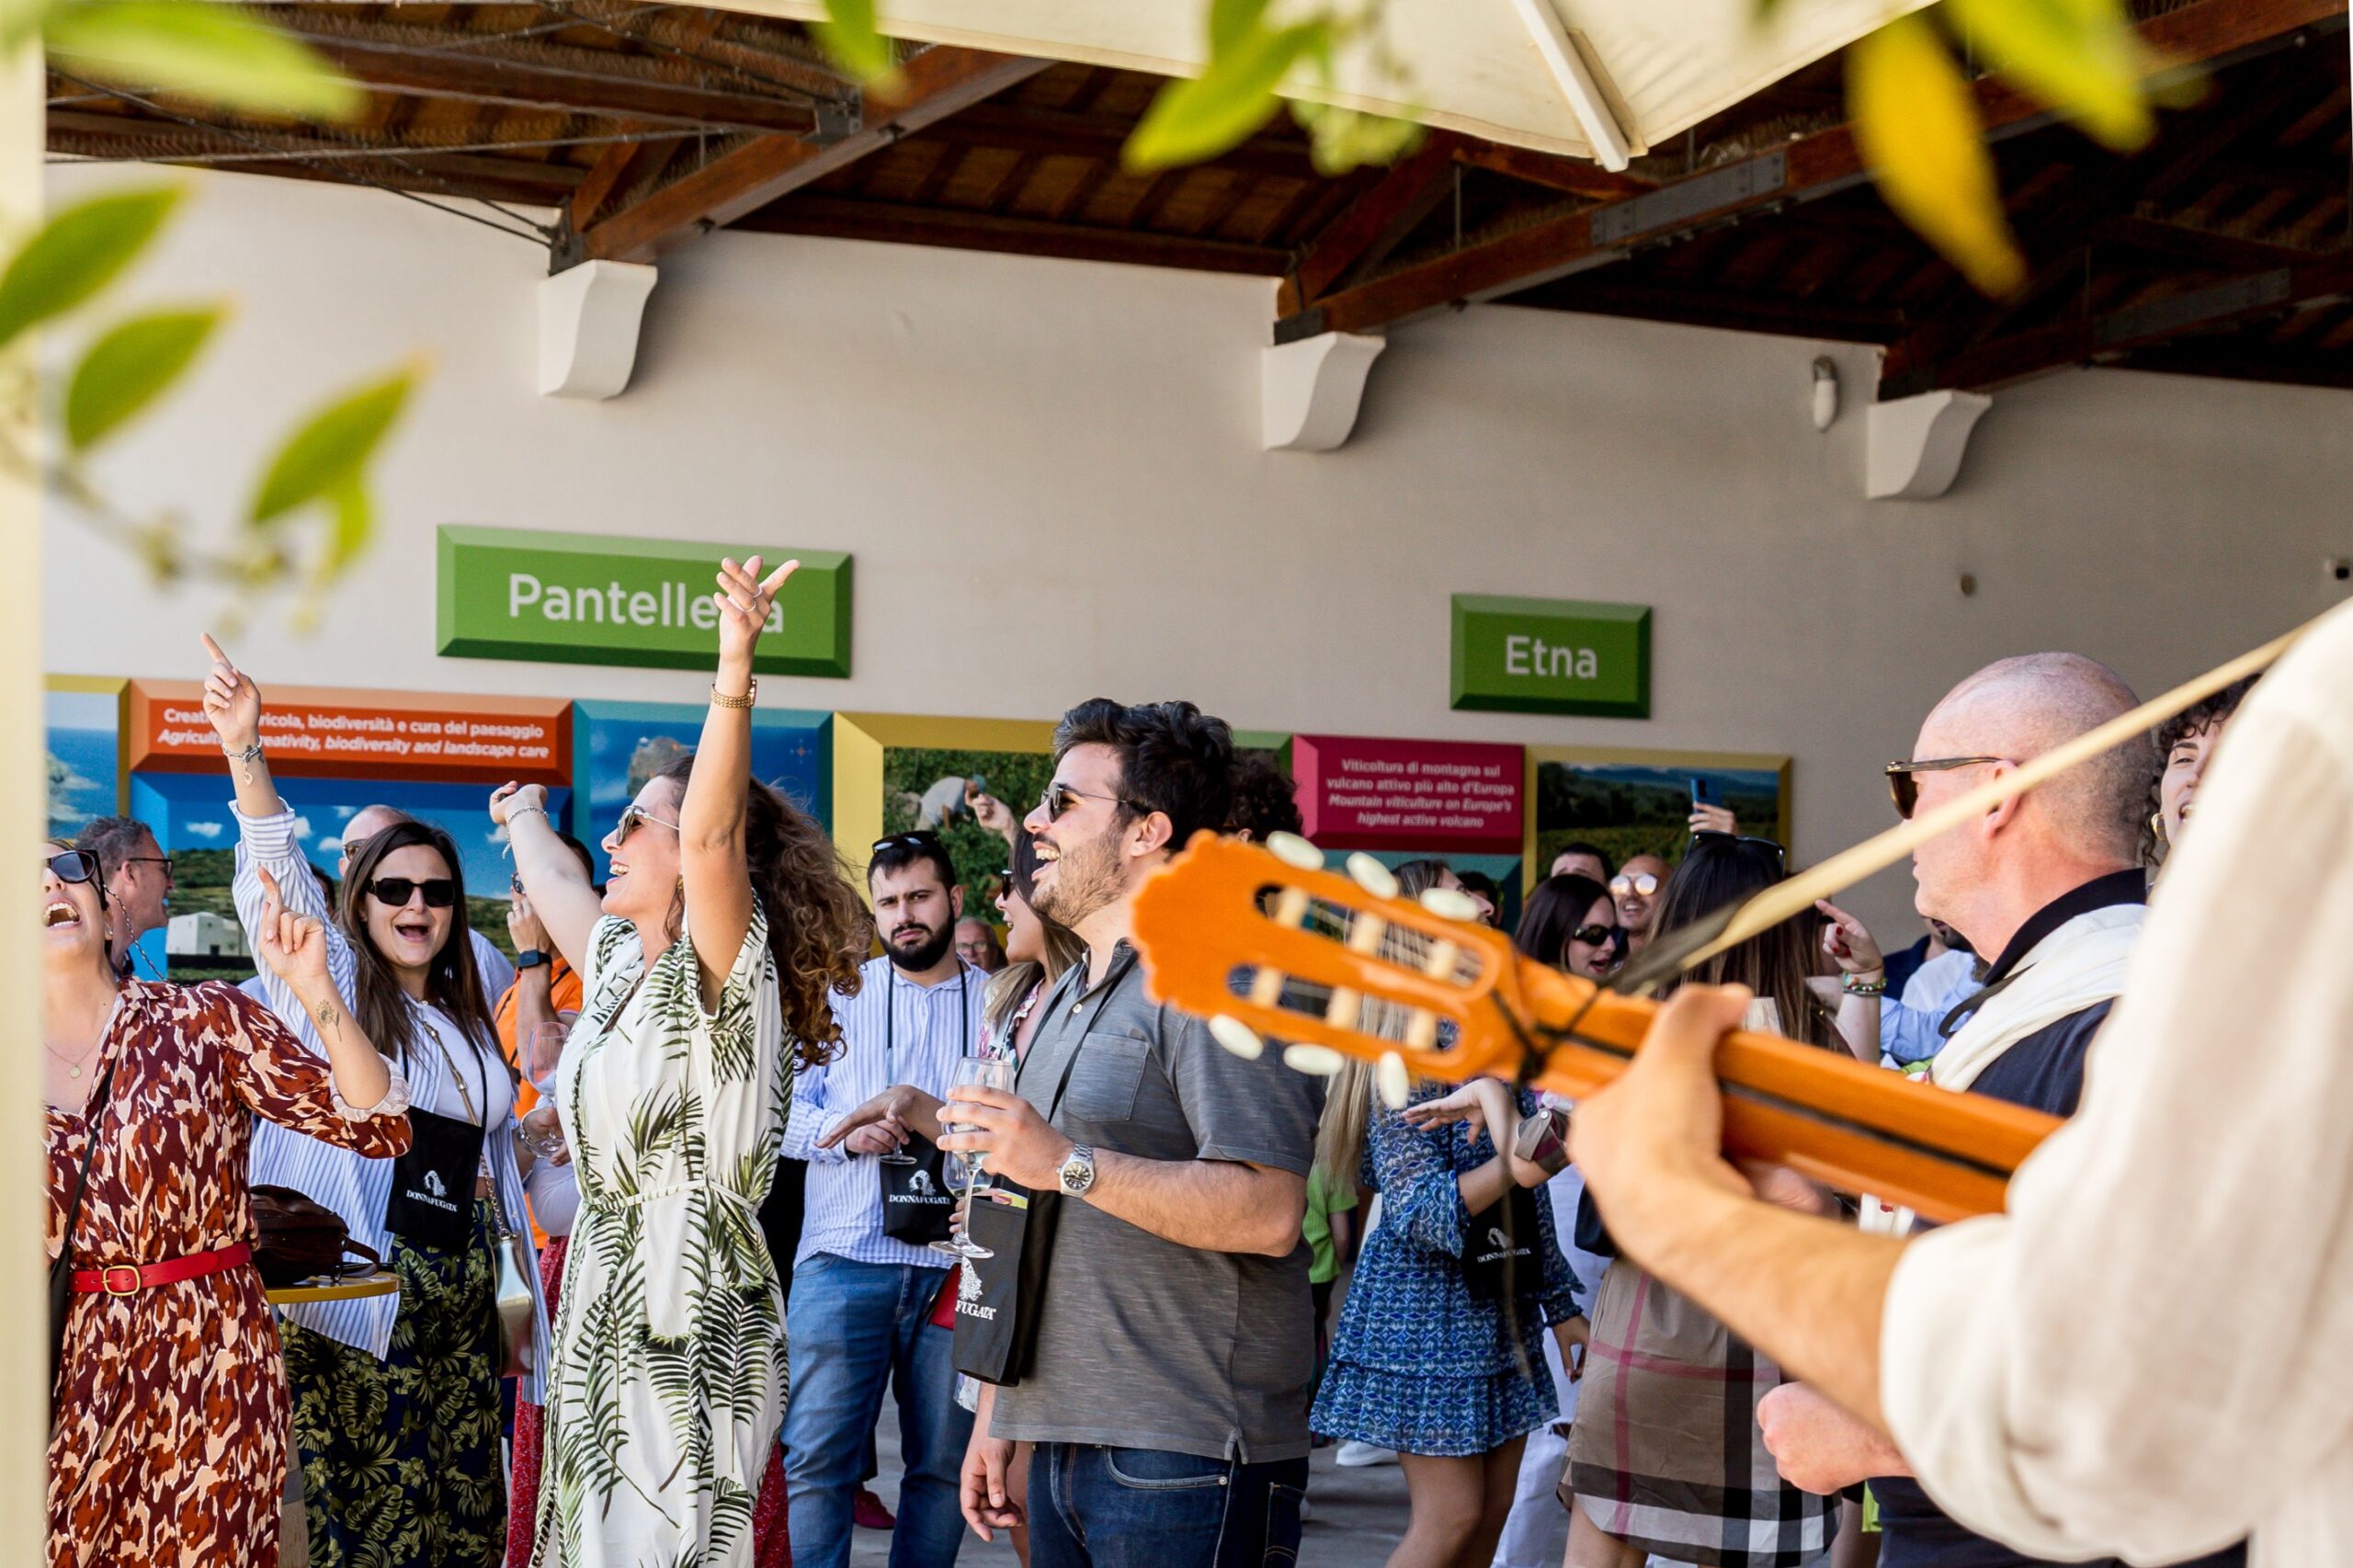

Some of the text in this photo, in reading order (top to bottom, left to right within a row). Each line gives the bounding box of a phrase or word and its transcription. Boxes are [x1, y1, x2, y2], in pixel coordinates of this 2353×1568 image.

[508, 573, 784, 634] Pantellea
[1506, 635, 1598, 678] Etna
[308, 713, 394, 733] biodiversità
[397, 721, 407, 733] e
[410, 722, 441, 733] cura
[444, 721, 468, 735] del
[470, 723, 544, 740] paesaggio
[261, 733, 322, 752] reativity,
[324, 734, 411, 755] biodiversity
[413, 740, 443, 754] and
[443, 741, 516, 758] landscape
[517, 745, 550, 758] care
[1341, 758, 1501, 778] Viticoltura di montagna sul
[1326, 776, 1374, 790] vulcano
[1377, 778, 1412, 791] attivo
[1414, 778, 1434, 794] più
[1437, 779, 1460, 793] alto
[1329, 793, 1382, 807] Mountain
[1386, 795, 1443, 809] viticulture
[1445, 799, 1461, 811] on
[1357, 812, 1484, 828] highest active volcano
[406, 1189, 458, 1212] DONNAFUGATA
